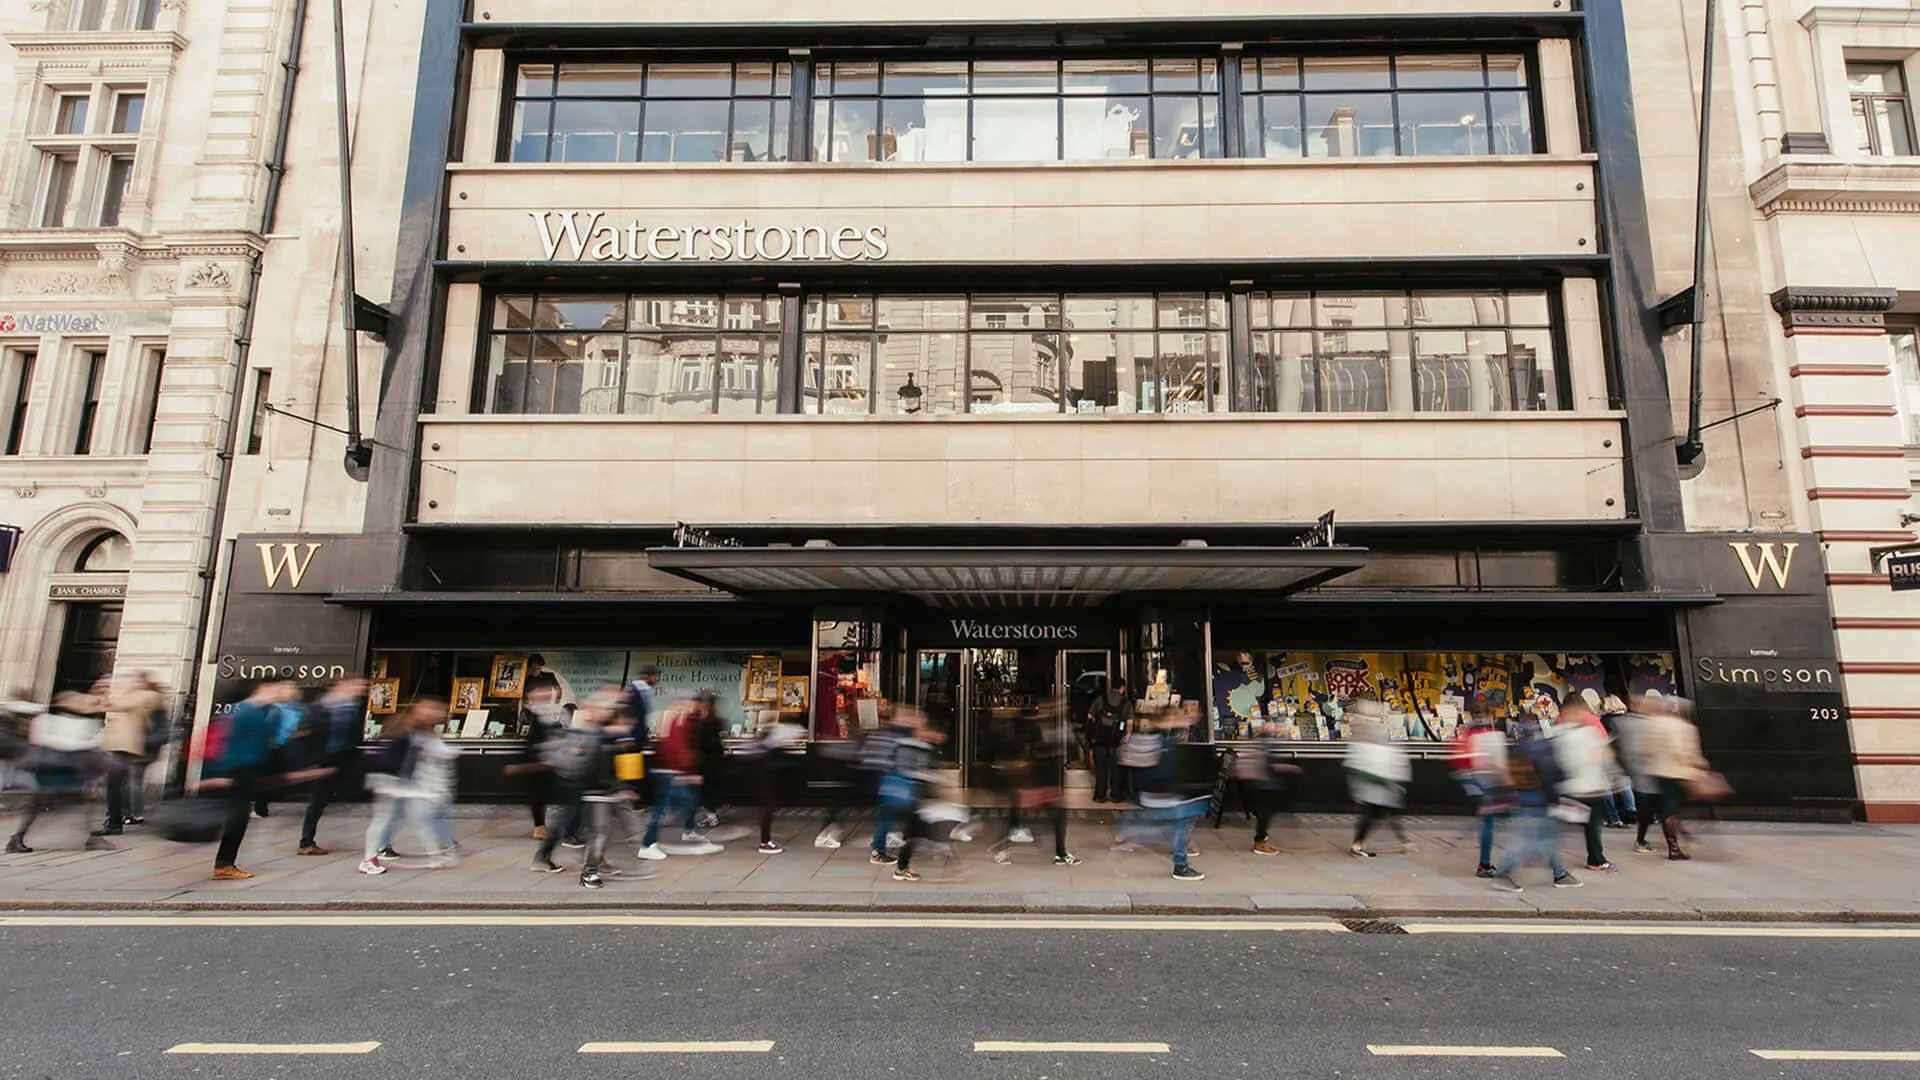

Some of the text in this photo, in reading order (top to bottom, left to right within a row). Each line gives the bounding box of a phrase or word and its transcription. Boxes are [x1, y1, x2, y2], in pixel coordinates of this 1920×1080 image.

[528, 210, 889, 262] Waterstones
[21, 313, 99, 332] NatWest
[255, 542, 322, 590] W
[1728, 542, 1800, 590] W
[57, 586, 121, 595] BANK CHAMBERS
[949, 619, 1078, 640] Waterstones
[272, 645, 301, 654] formerly
[1750, 648, 1778, 657] formerly
[656, 655, 717, 668] Elizabeth
[656, 670, 742, 683] Jane Howard
[1325, 670, 1370, 688] BOOK
[1809, 707, 1840, 720] 203
